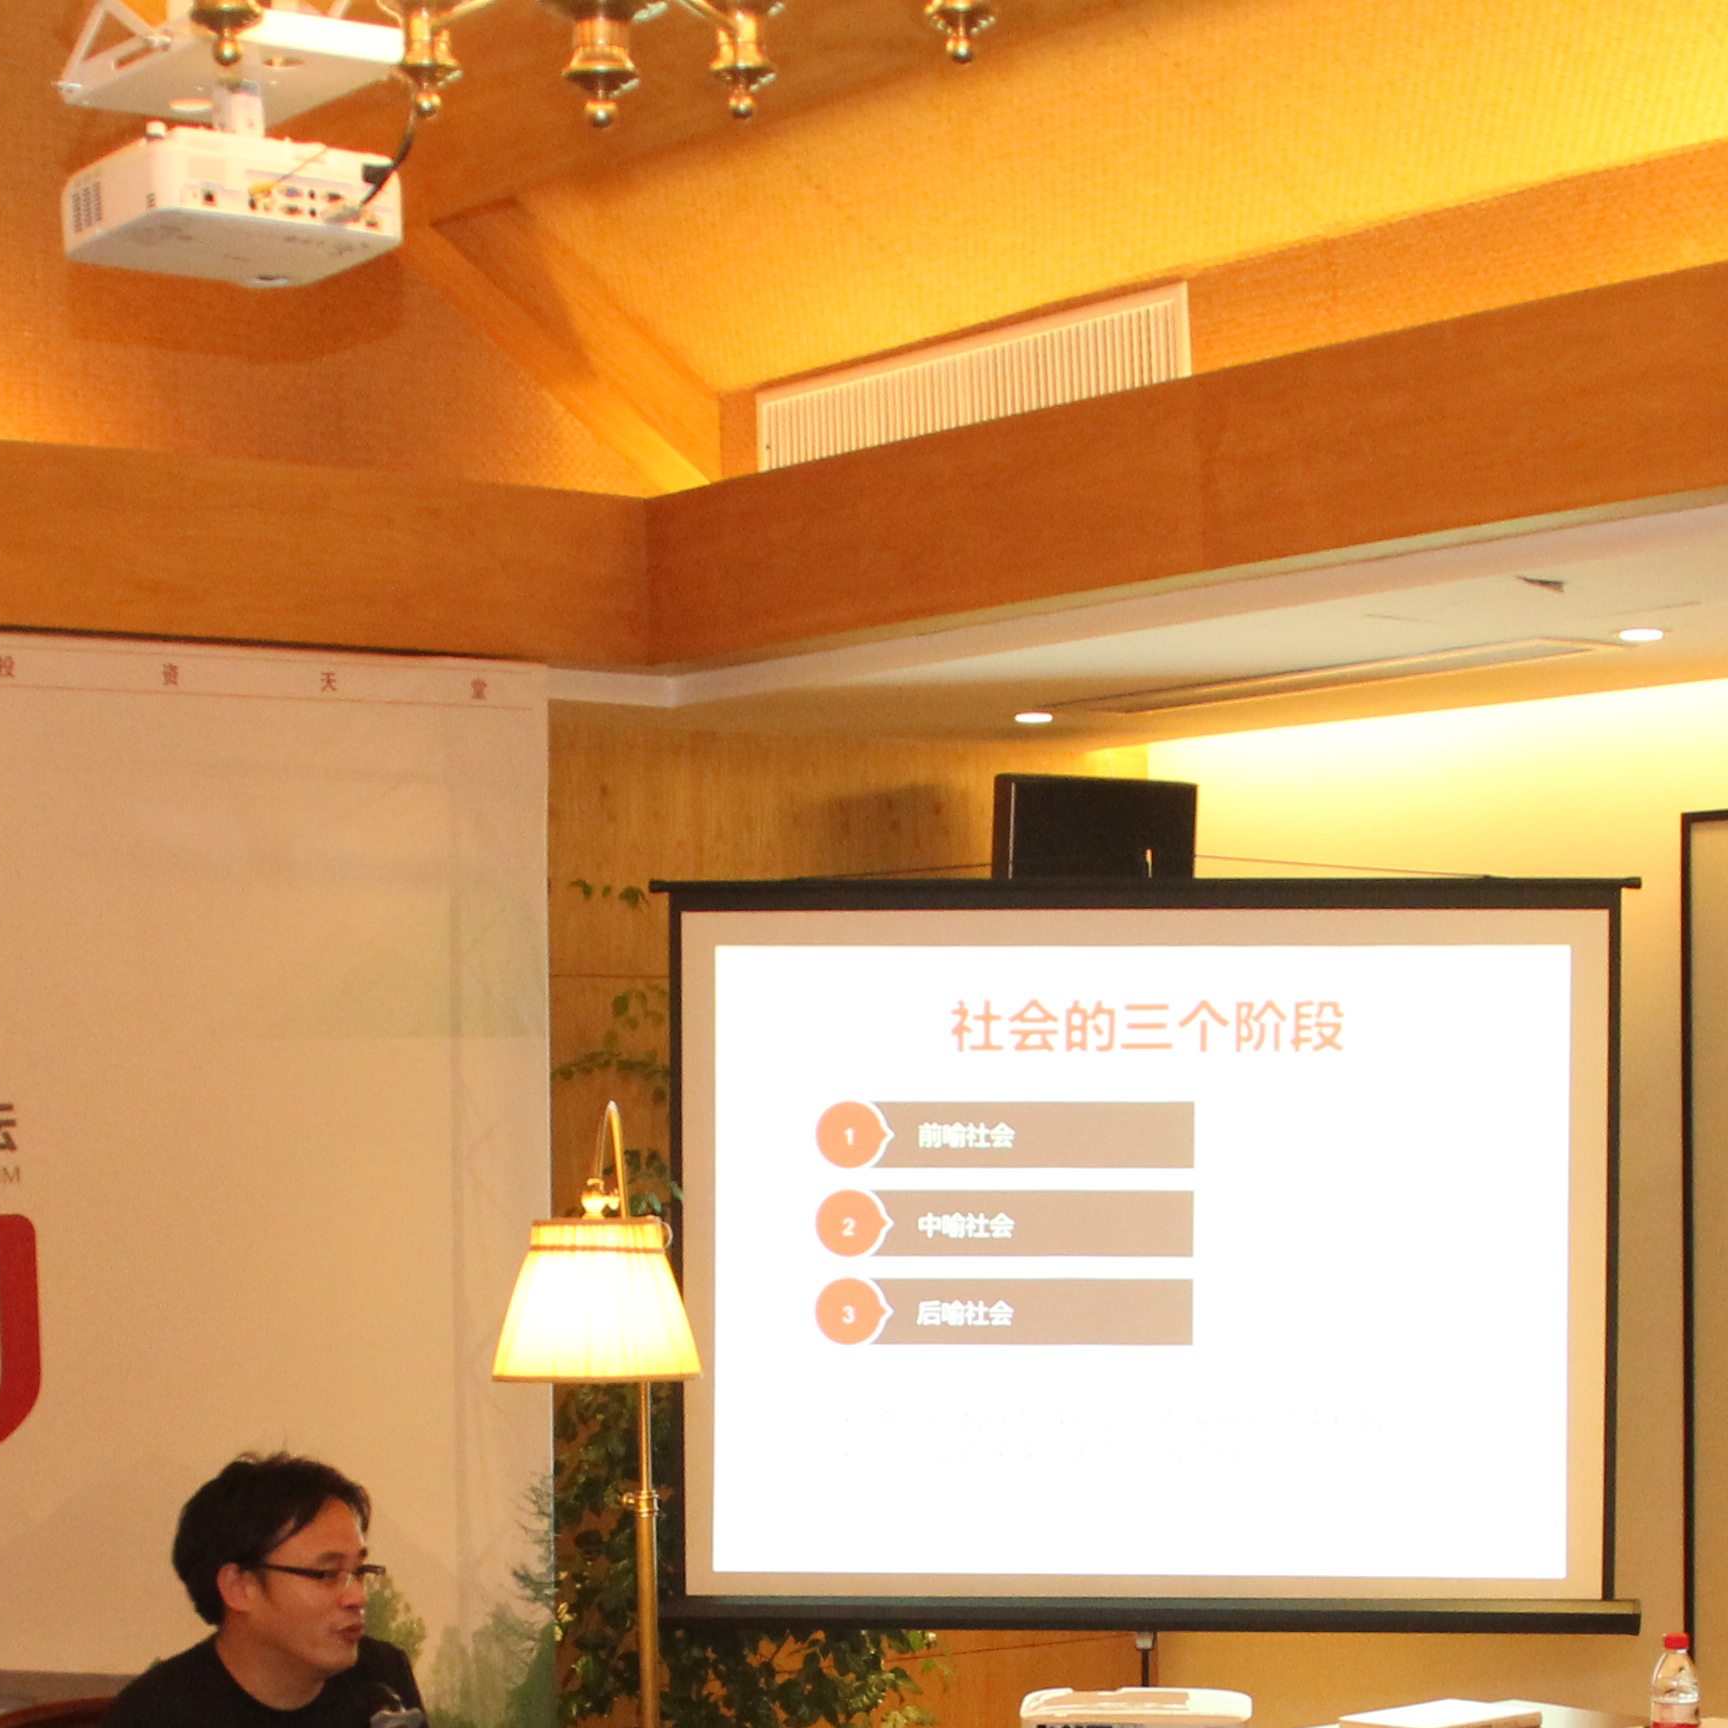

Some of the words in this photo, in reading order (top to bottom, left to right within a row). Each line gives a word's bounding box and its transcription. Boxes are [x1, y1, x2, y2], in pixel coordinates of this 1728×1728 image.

[950, 998, 1346, 1053] 社会的三个阶段
[843, 1127, 856, 1146] 1
[917, 1121, 1017, 1150] 前喻社会
[841, 1216, 857, 1237] 2
[917, 1211, 1016, 1239] 中喻社会
[841, 1304, 857, 1325] 3
[915, 1298, 1015, 1327] 后喻社会
